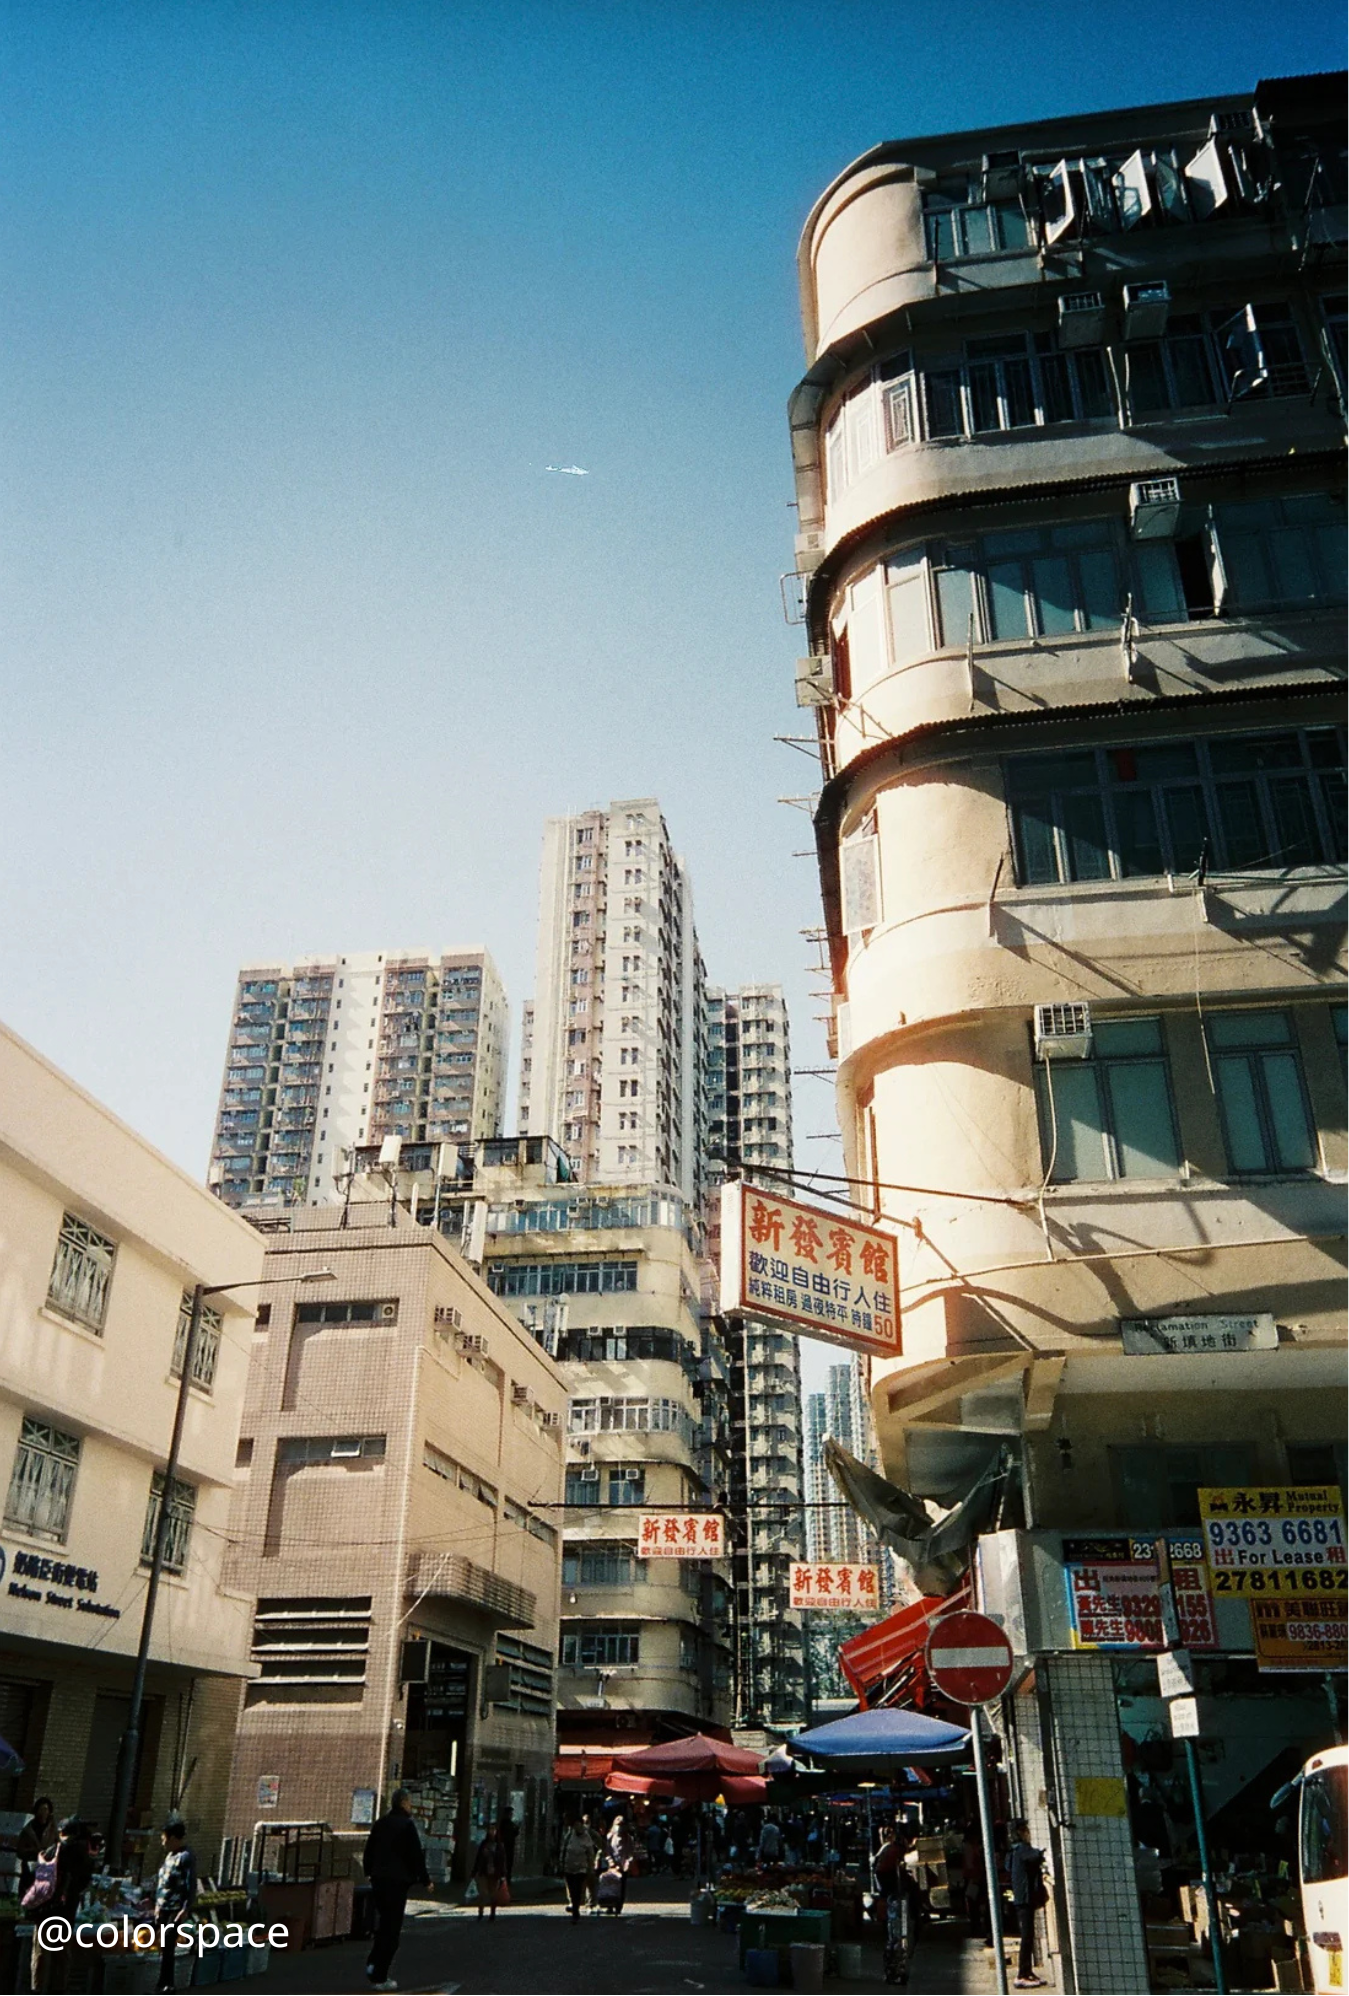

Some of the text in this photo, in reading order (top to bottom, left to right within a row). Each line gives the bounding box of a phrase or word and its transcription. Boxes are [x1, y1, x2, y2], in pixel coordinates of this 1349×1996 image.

[748, 1199, 889, 1285] 新發賓館
[748, 1250, 892, 1314] 歡迎自由行人住
[874, 1314, 894, 1339] 50
[1220, 1318, 1260, 1330] Street
[1286, 1501, 1340, 1514] Property
[641, 1517, 721, 1545] 新發賓館
[1209, 1519, 1342, 1546] 9363 6681
[1214, 1548, 1235, 1566] 出
[1238, 1549, 1266, 1565] For
[1272, 1549, 1324, 1564] Lease
[793, 1565, 876, 1595] 新發賓館
[1074, 1568, 1101, 1591] 出
[1214, 1569, 1347, 1591] 27811682
